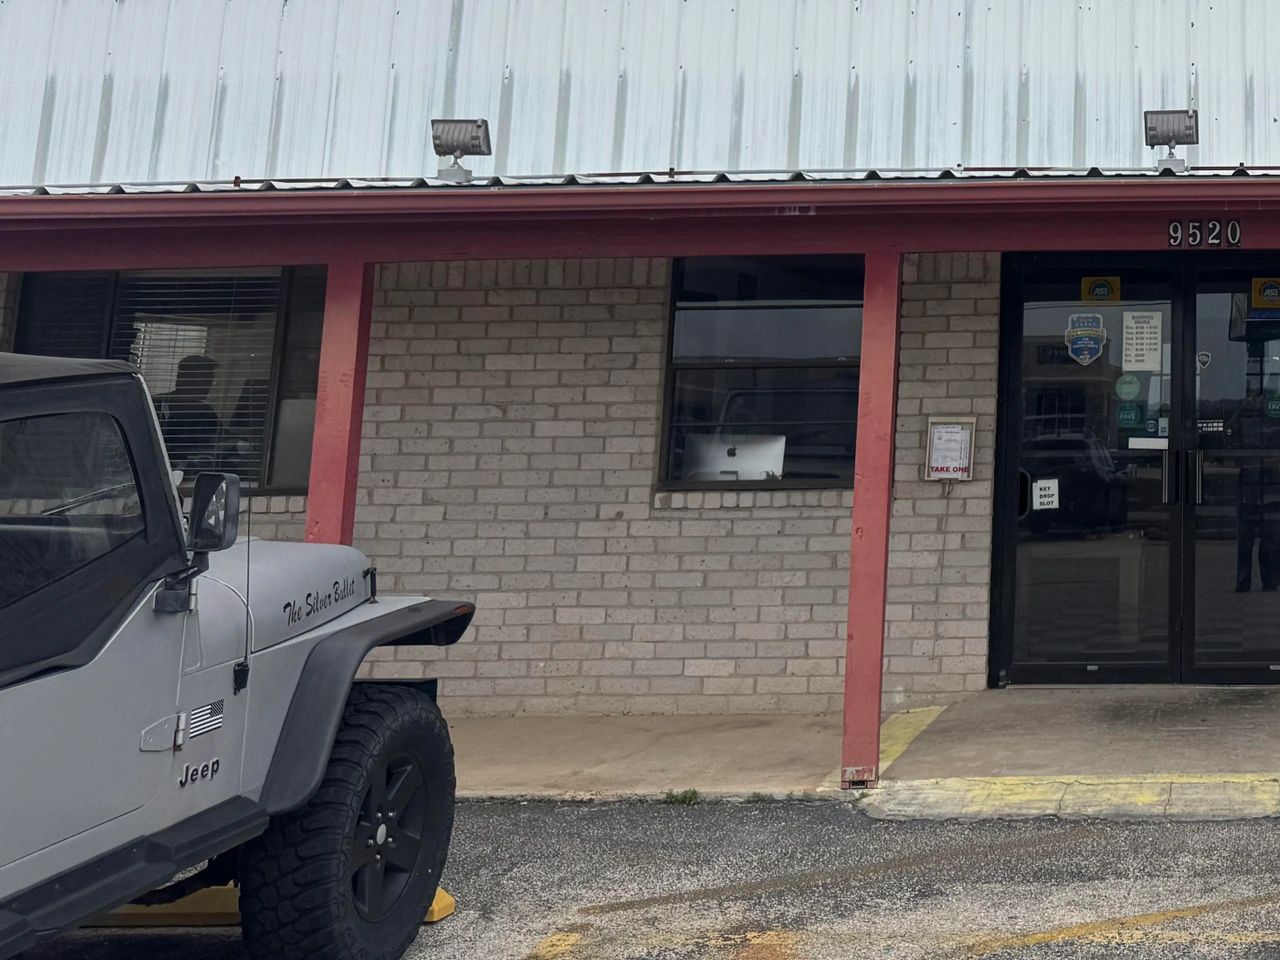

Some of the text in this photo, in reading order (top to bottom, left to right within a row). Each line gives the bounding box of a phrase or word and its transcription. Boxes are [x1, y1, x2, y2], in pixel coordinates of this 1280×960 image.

[1169, 220, 1241, 246] 9520
[283, 577, 355, 627] The Silver Bullet
[178, 758, 220, 788] Jeep
